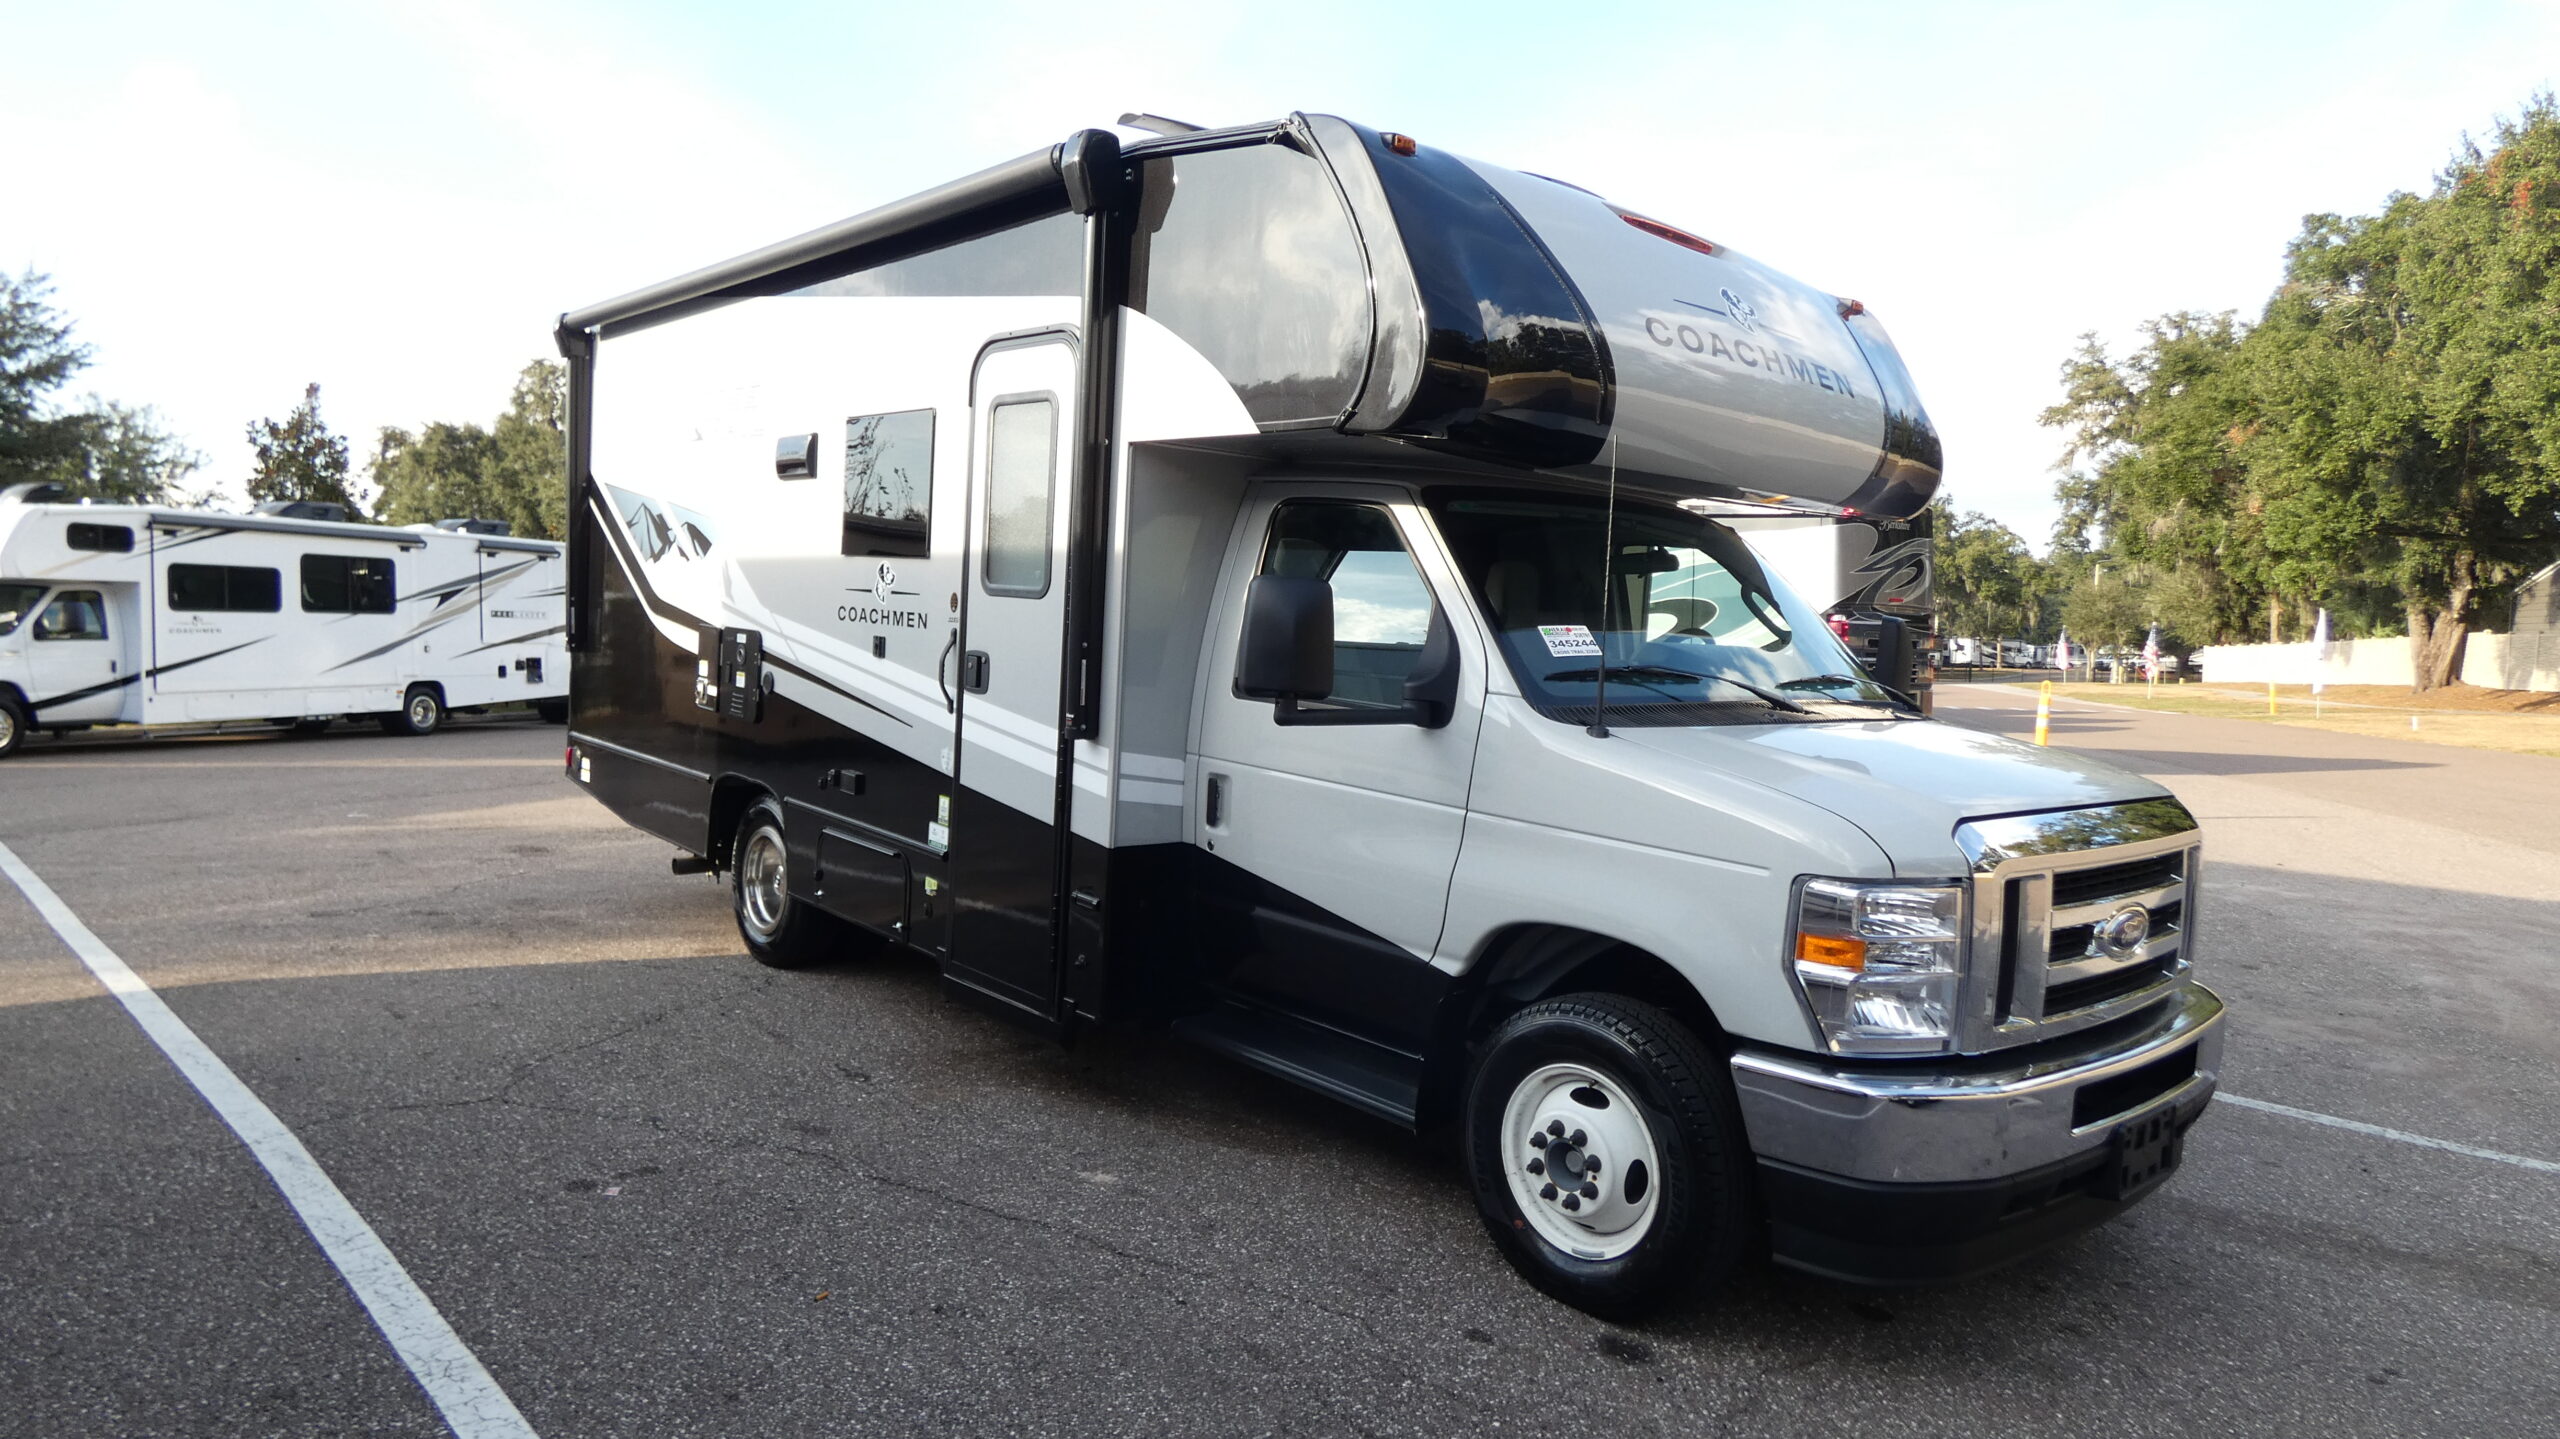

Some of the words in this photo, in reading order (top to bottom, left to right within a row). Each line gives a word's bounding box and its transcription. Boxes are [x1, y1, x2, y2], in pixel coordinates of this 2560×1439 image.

[1645, 317, 1855, 399] COACHMEN
[837, 606, 928, 630] COACHMEN
[1549, 640, 1597, 648] 345244
